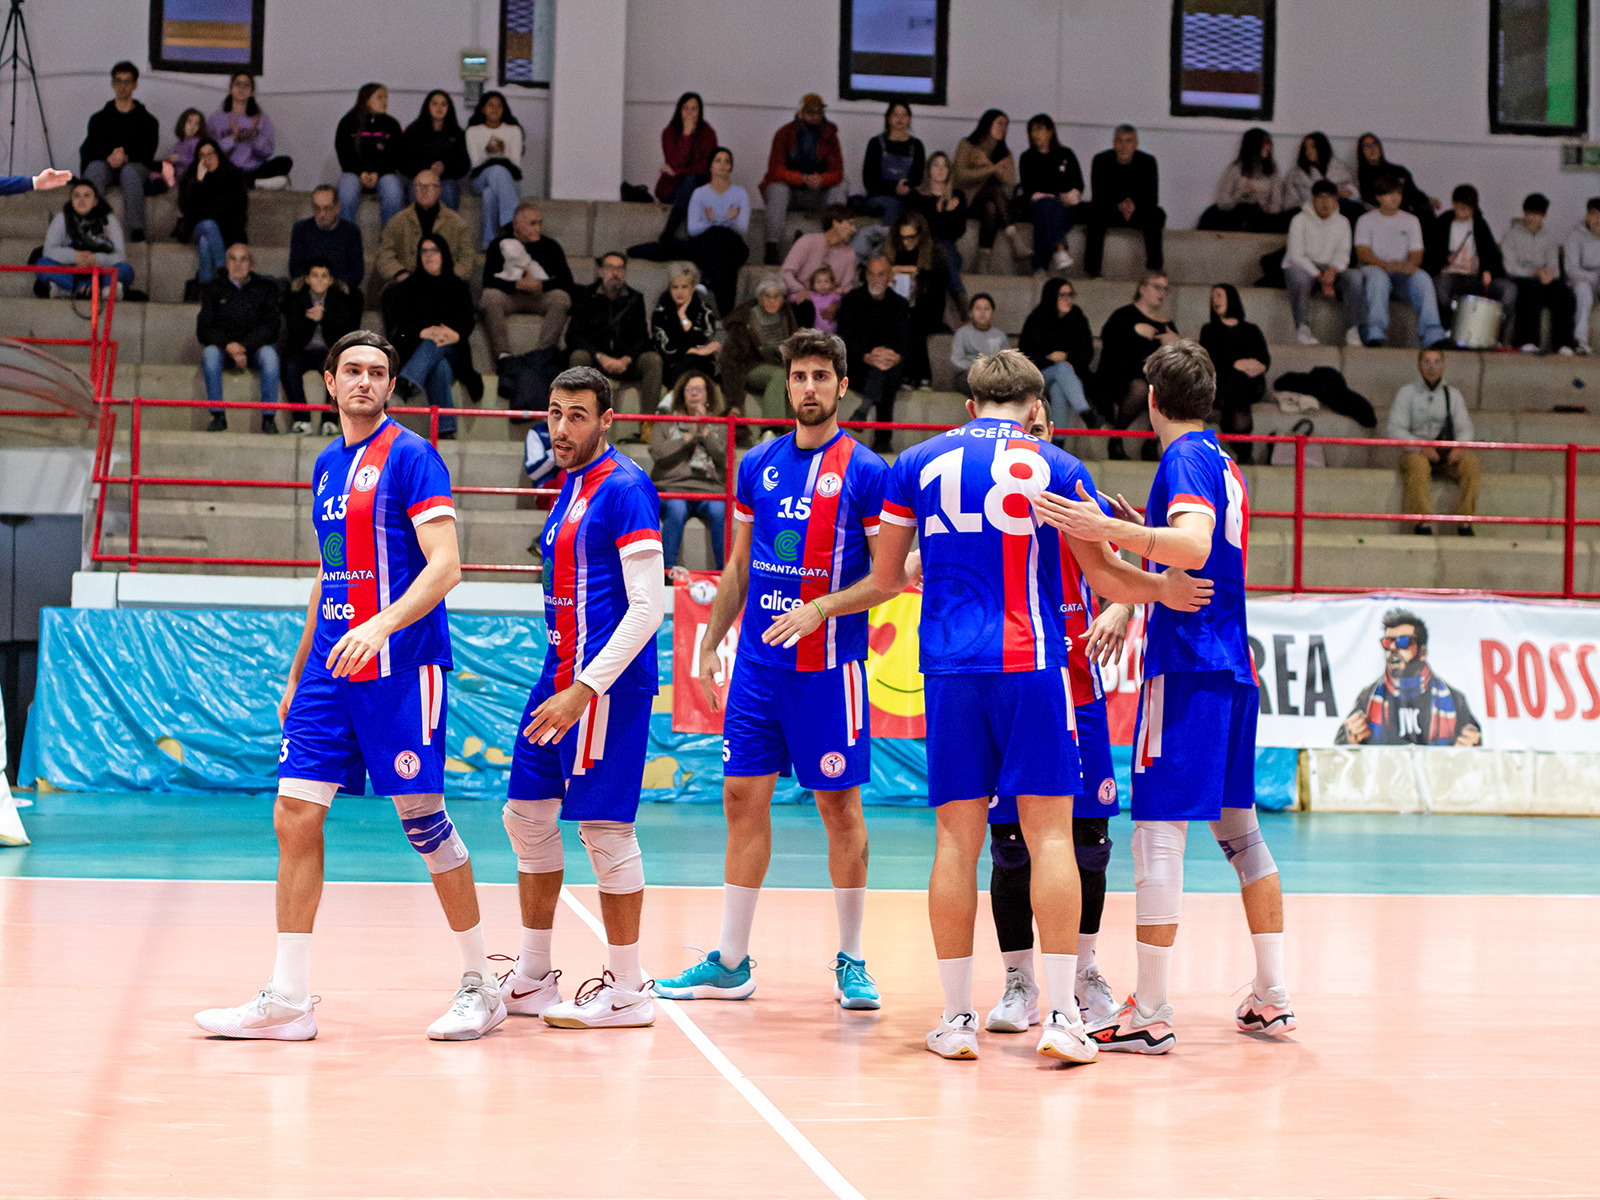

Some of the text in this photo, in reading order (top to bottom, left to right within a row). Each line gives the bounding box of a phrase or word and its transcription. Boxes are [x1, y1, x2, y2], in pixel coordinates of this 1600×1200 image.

[945, 426, 1039, 442] DI CERBO
[919, 446, 1051, 538] 18
[321, 494, 350, 521] 13
[777, 496, 812, 520] 15
[545, 522, 558, 546] 6
[752, 559, 829, 578] ECOSANTAGATA
[322, 597, 356, 620] alice
[760, 589, 805, 612] alice
[1480, 639, 1600, 720] ROSS
